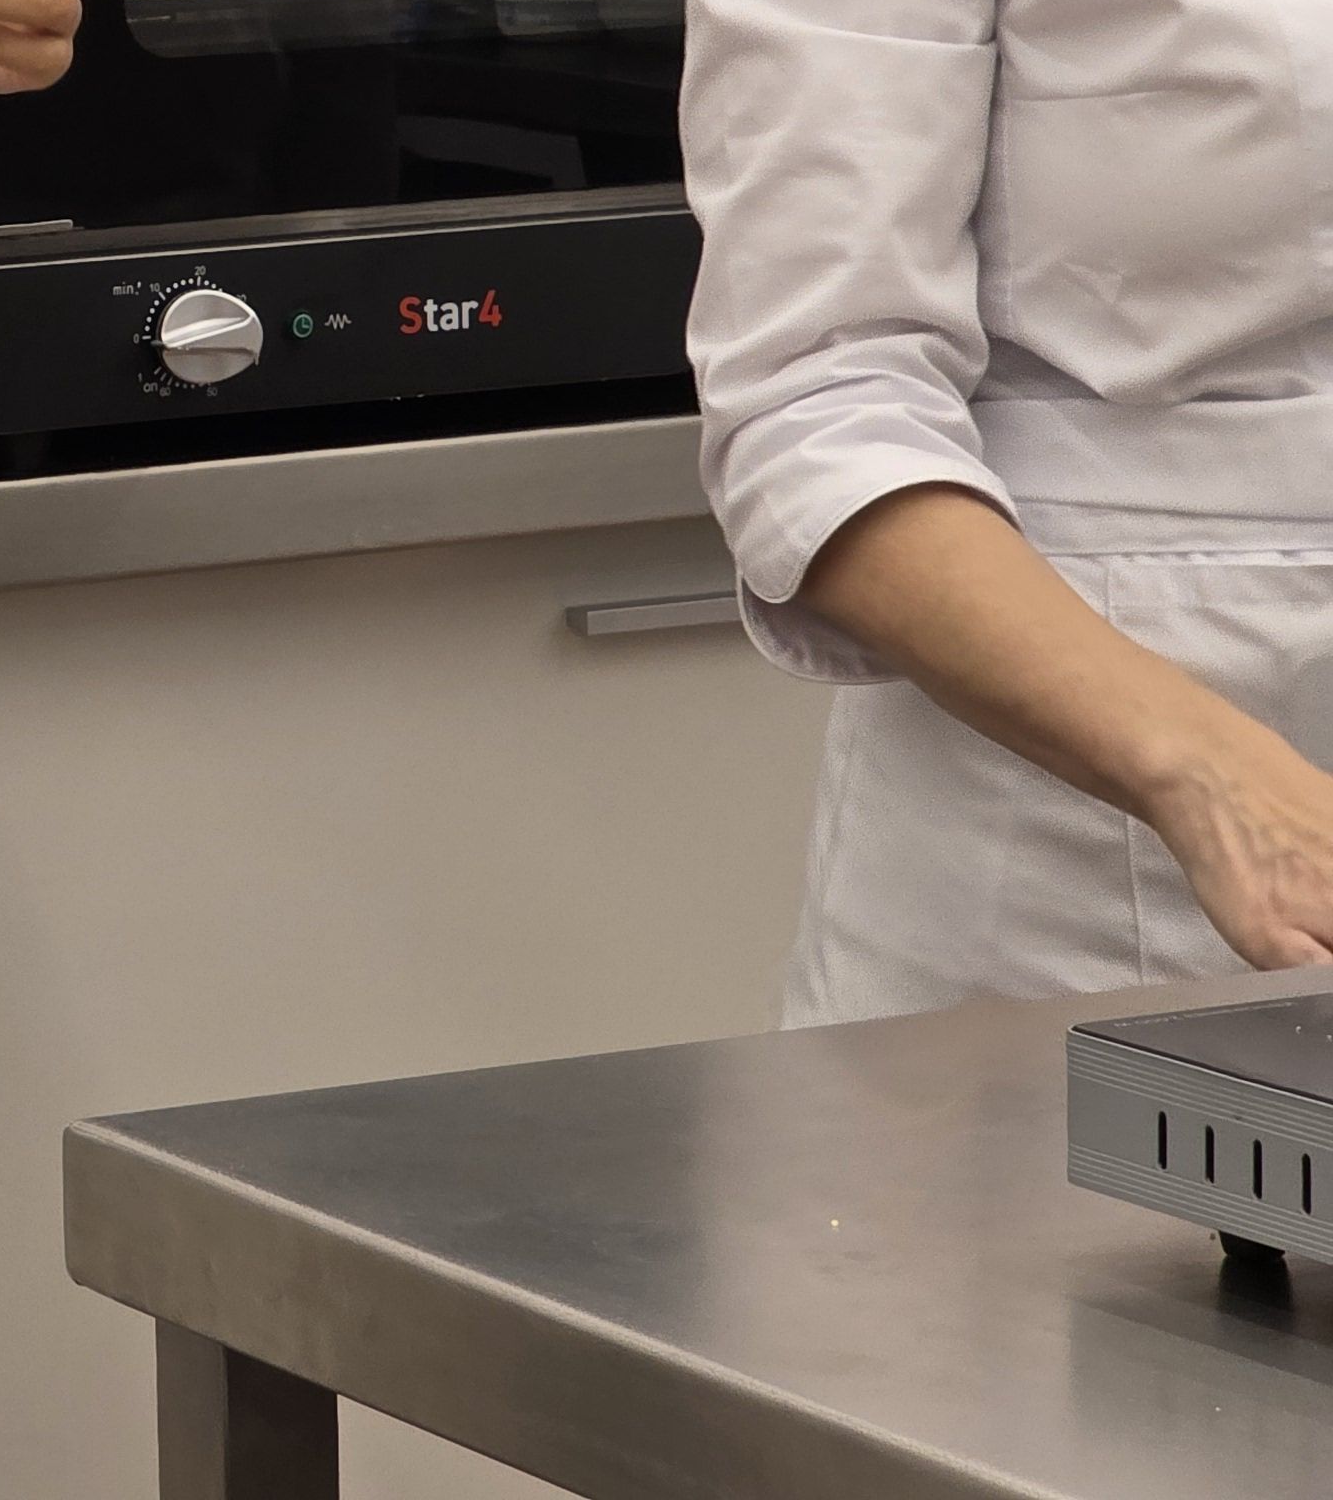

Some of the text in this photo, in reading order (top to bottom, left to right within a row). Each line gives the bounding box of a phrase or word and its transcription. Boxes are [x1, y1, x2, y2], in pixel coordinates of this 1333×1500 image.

[194, 265, 207, 276] 20
[149, 283, 160, 293] 10
[397, 288, 504, 335] Star4
[133, 333, 140, 344] 0
[143, 383, 158, 393] on
[159, 387, 171, 397] 60
[207, 387, 218, 397] 50
